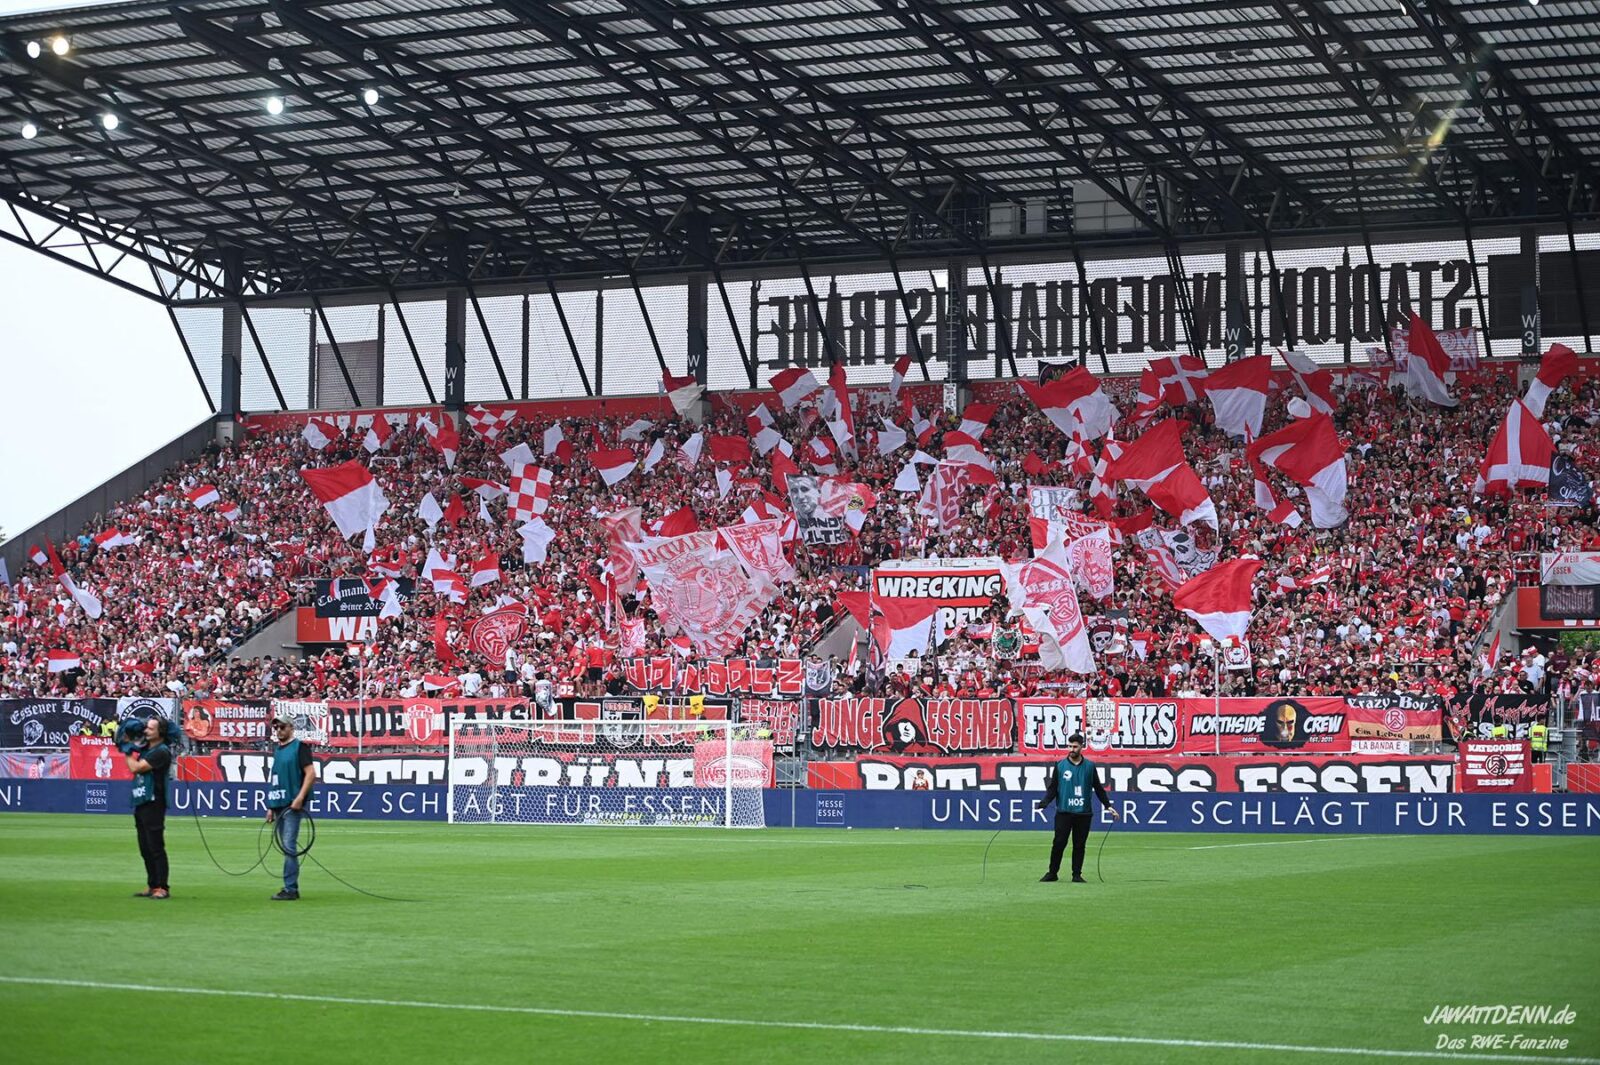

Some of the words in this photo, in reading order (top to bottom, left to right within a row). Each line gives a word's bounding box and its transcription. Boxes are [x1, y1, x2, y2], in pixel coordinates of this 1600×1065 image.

[1522, 314, 1536, 327] W
[1226, 327, 1240, 340] W
[1523, 330, 1535, 347] 3
[877, 576, 1000, 598] WRECKING
[340, 602, 362, 611] Since
[940, 606, 989, 628] REW
[10, 701, 57, 725] Essener
[62, 701, 102, 726] Löwen
[330, 706, 406, 737] RUDE
[442, 704, 526, 737] FANS
[220, 722, 266, 737] ESSEN
[812, 699, 886, 748] JUNGE
[927, 699, 1015, 749] ESSENER
[1191, 715, 1266, 734] NORTHSIDE
[1303, 714, 1343, 734] CREW
[44, 731, 70, 745] 1980
[1370, 741, 1394, 750] BANDA
[220, 754, 694, 788] WSTTRIBÜNE
[861, 763, 1212, 793] ROT-WISS
[1239, 764, 1452, 793] ESSEN
[174, 789, 269, 811] UNSER
[309, 791, 363, 812] ERZ
[382, 787, 527, 816] SCHLÄGT
[546, 789, 601, 816] FÜR
[624, 795, 720, 815] ESSEN
[818, 800, 843, 808] MESSE
[818, 809, 843, 817] ESSEN
[932, 798, 1048, 822] UNSER
[1101, 800, 1168, 824] ERZ
[1191, 797, 1370, 826] SCHLÄGT
[1395, 797, 1466, 827] FÜR
